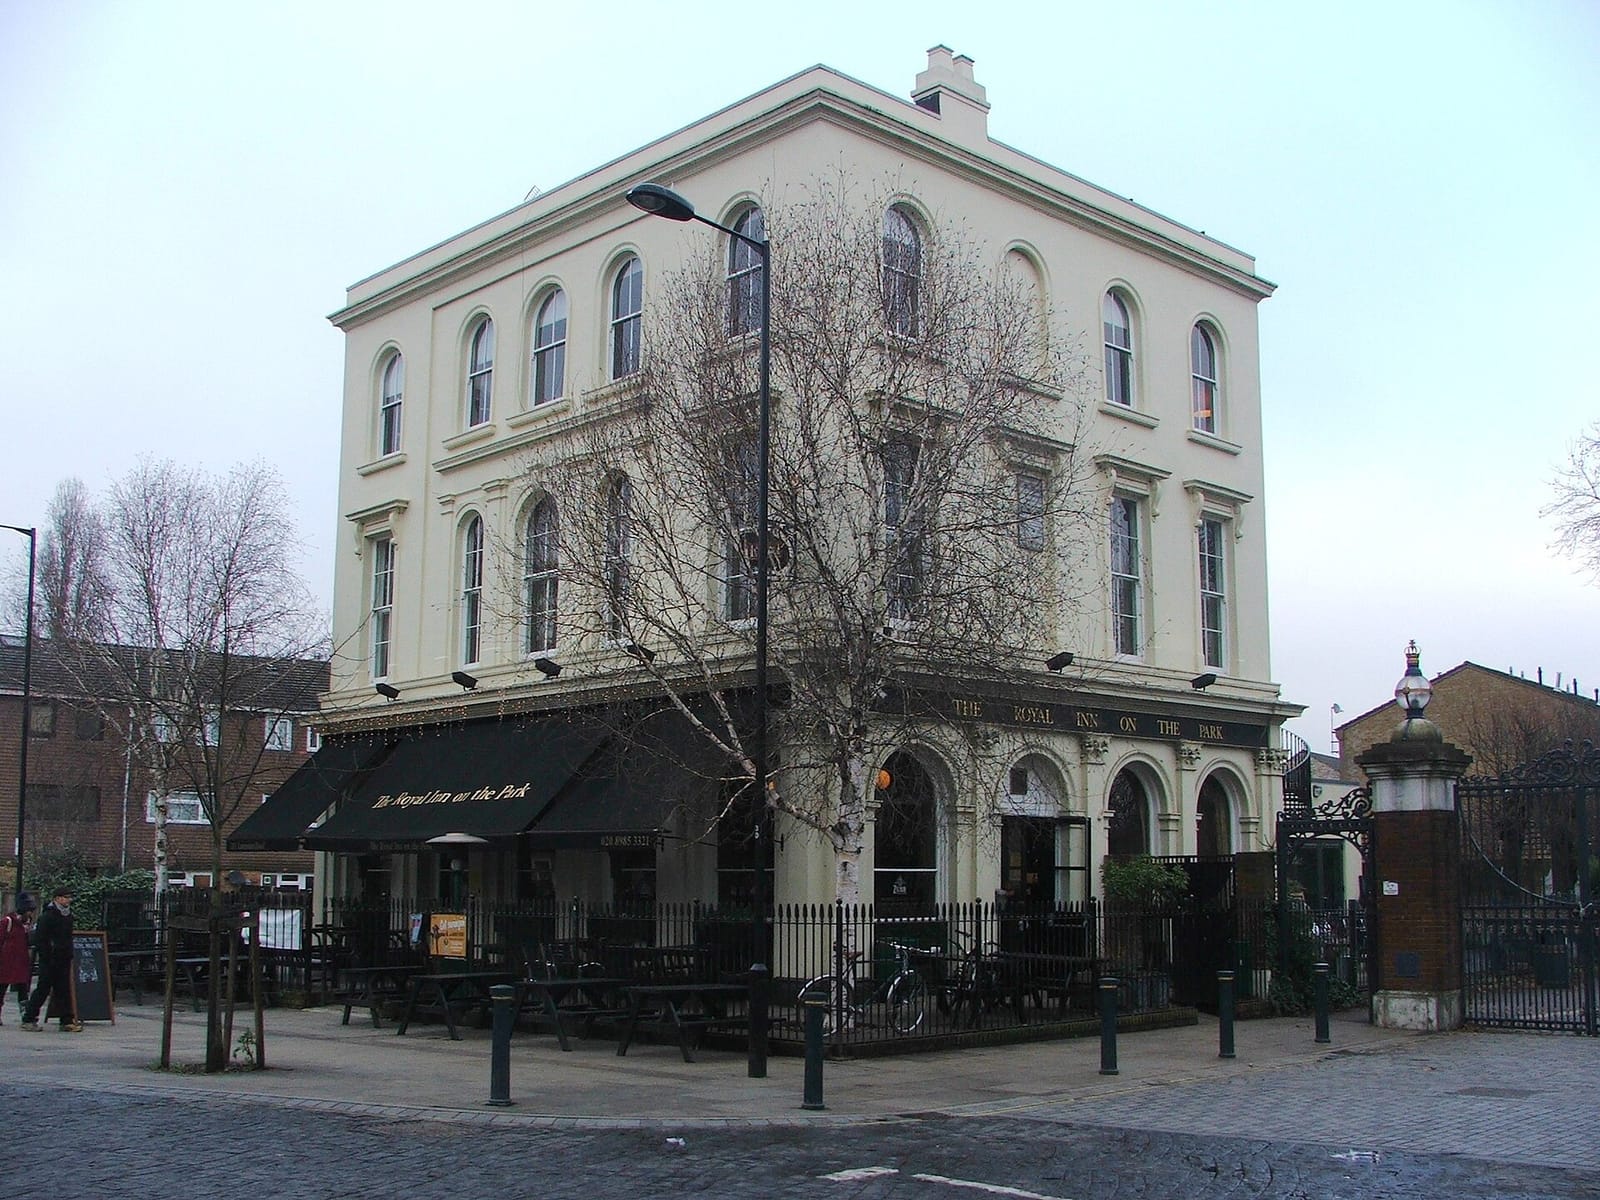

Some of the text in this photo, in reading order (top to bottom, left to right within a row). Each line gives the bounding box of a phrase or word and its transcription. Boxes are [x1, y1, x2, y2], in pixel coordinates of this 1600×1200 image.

[952, 699, 1224, 740] THE ROYAL INN ON THE PARK
[372, 782, 532, 809] The Royal Inn on the Park
